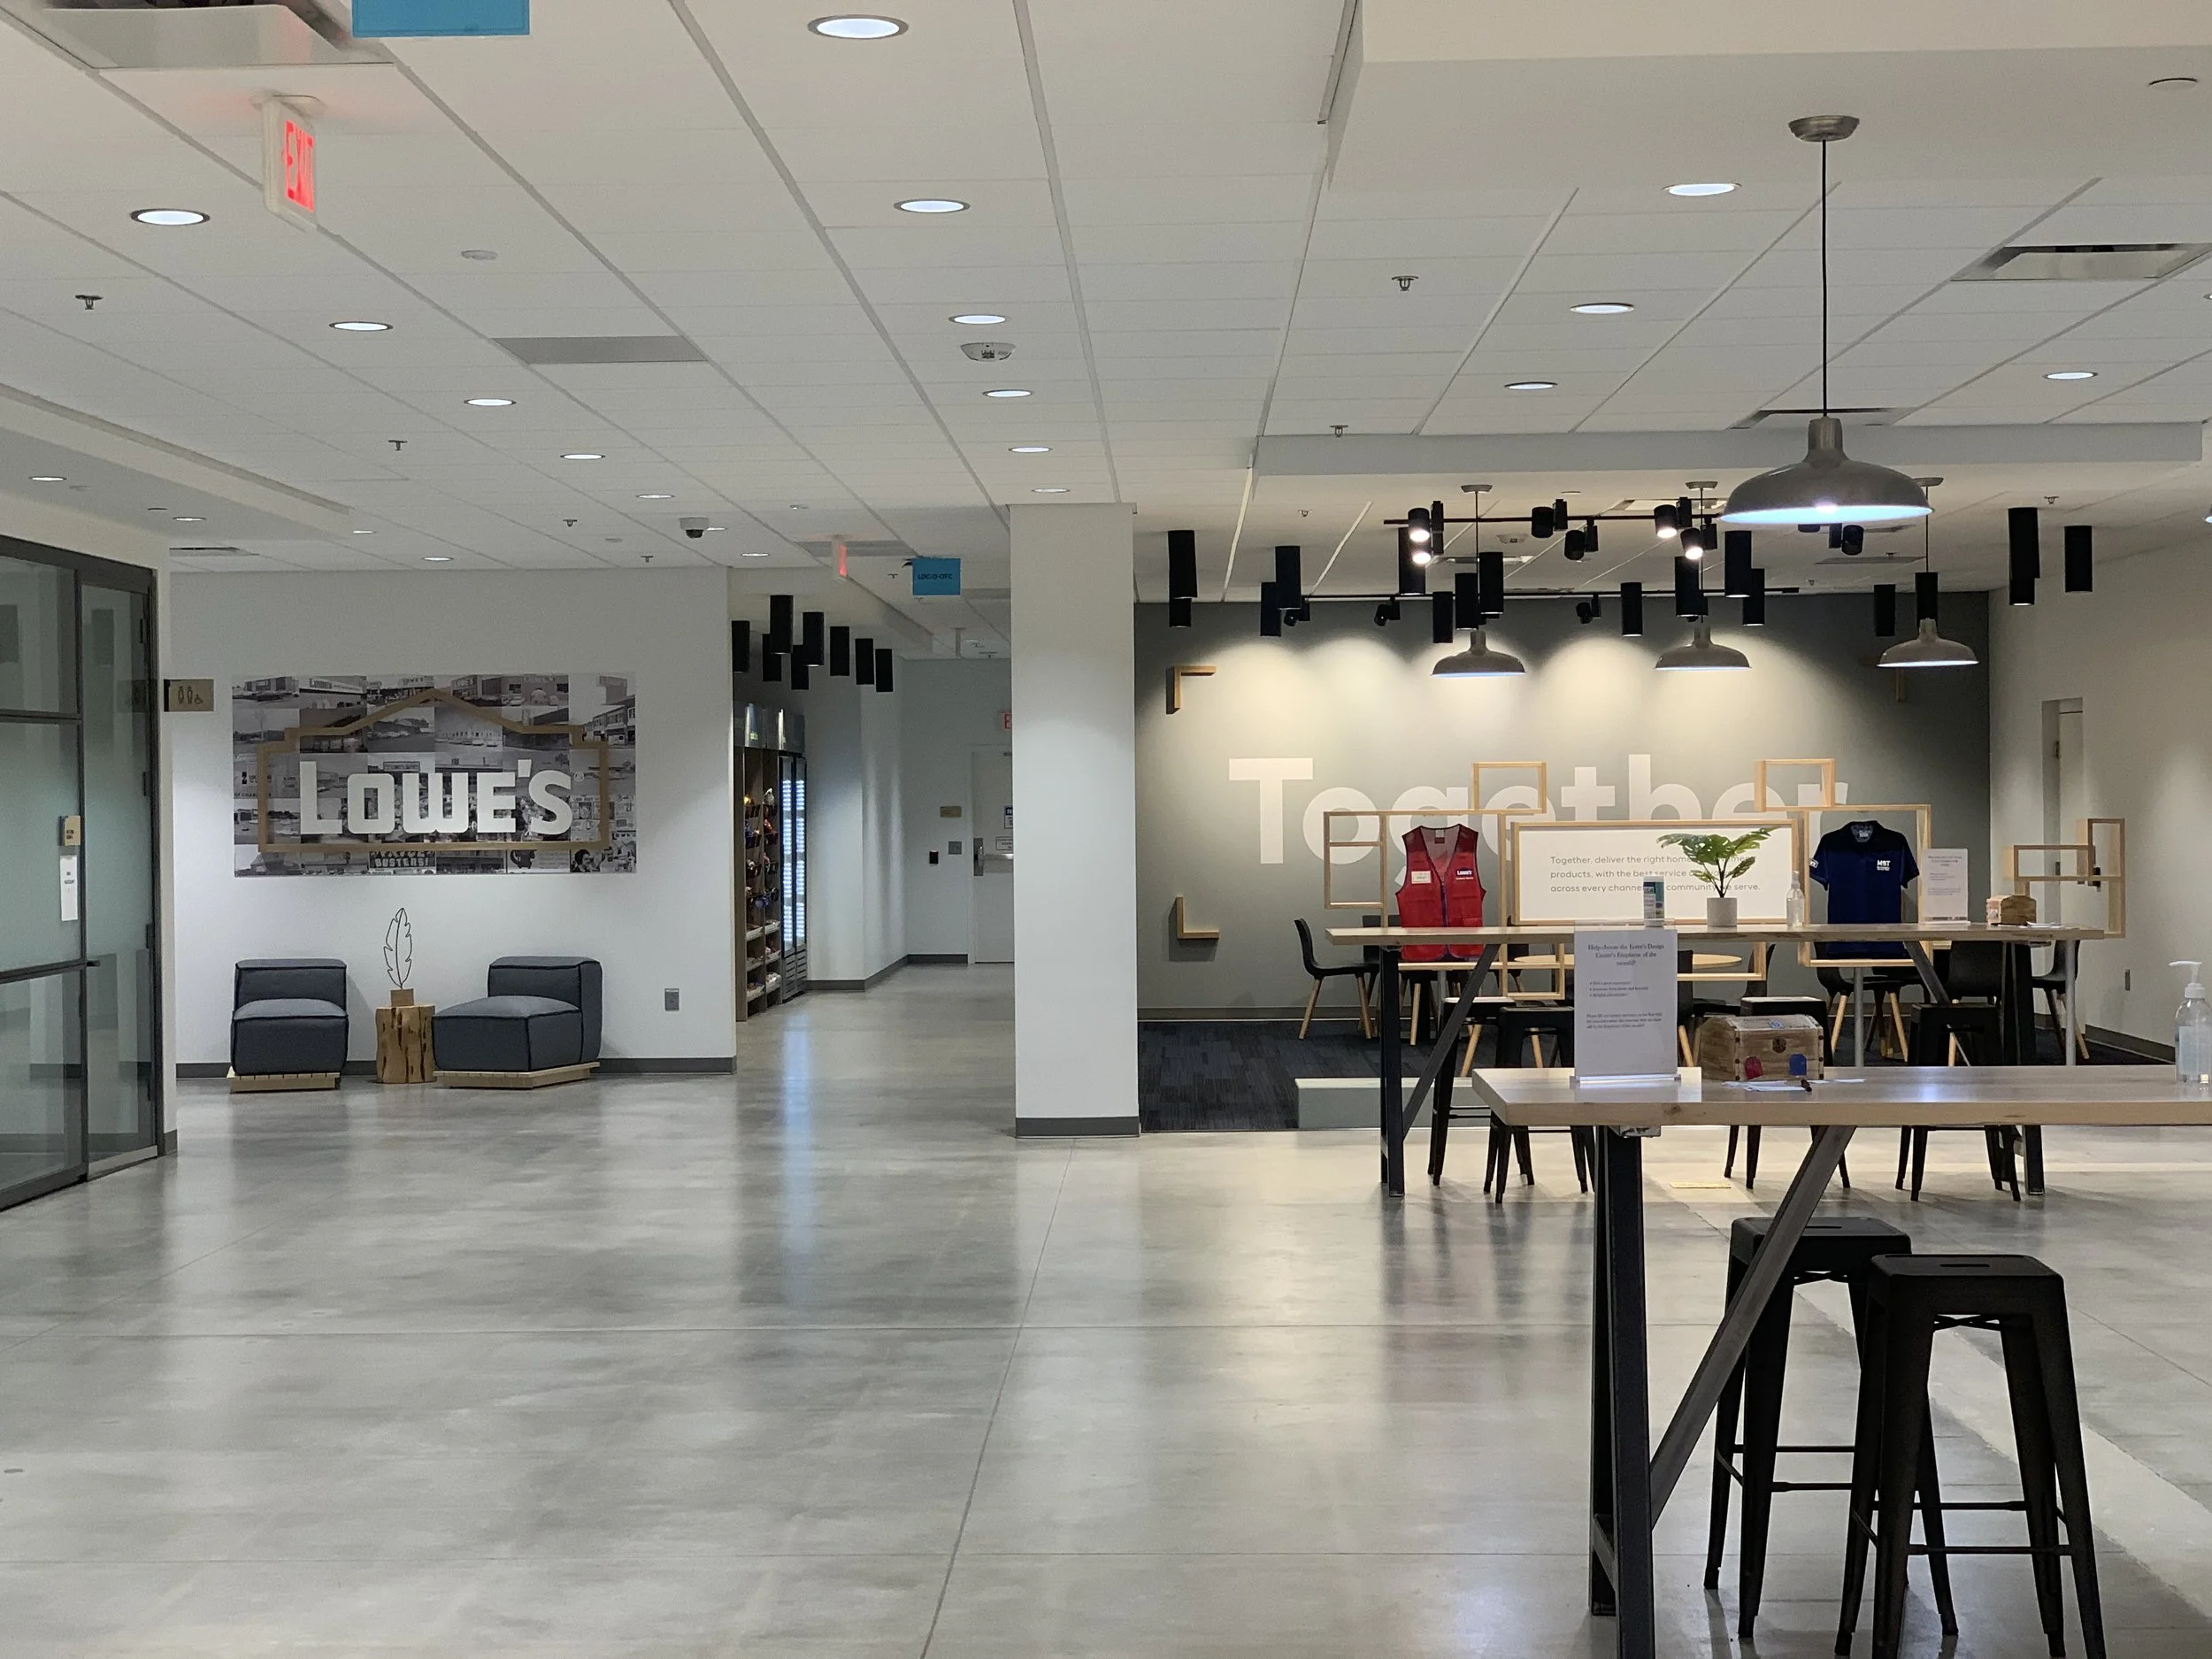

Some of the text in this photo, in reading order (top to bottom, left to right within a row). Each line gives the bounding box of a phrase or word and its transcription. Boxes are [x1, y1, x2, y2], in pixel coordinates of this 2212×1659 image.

[286, 119, 315, 212] EXIT
[300, 759, 573, 835] LOWE'S
[374, 857, 429, 867] BUSTERS!
[1550, 856, 1593, 865] Together,
[1643, 856, 1664, 864] right
[1550, 871, 1594, 879] products,
